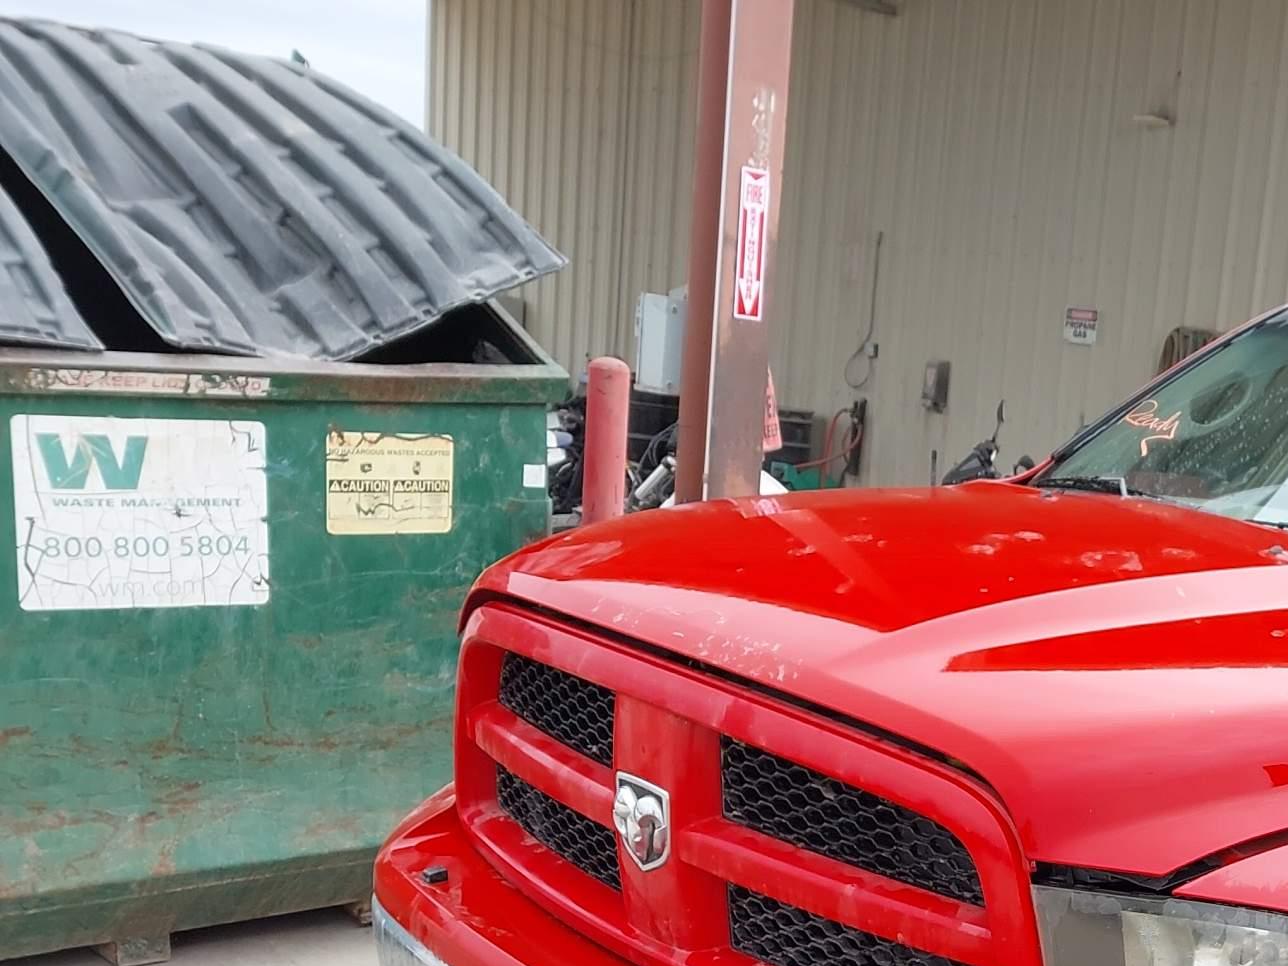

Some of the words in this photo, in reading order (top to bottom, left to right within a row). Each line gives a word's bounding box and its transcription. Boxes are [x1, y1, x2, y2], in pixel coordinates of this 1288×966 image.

[1124, 399, 1182, 457] Ready
[341, 480, 389, 492] CAUTION
[404, 480, 449, 492] CAUTION
[53, 498, 114, 508] WASTE
[121, 498, 241, 508] MANGEMENT
[43, 536, 103, 559] 800
[114, 535, 170, 558] 800
[180, 534, 250, 558] 5804
